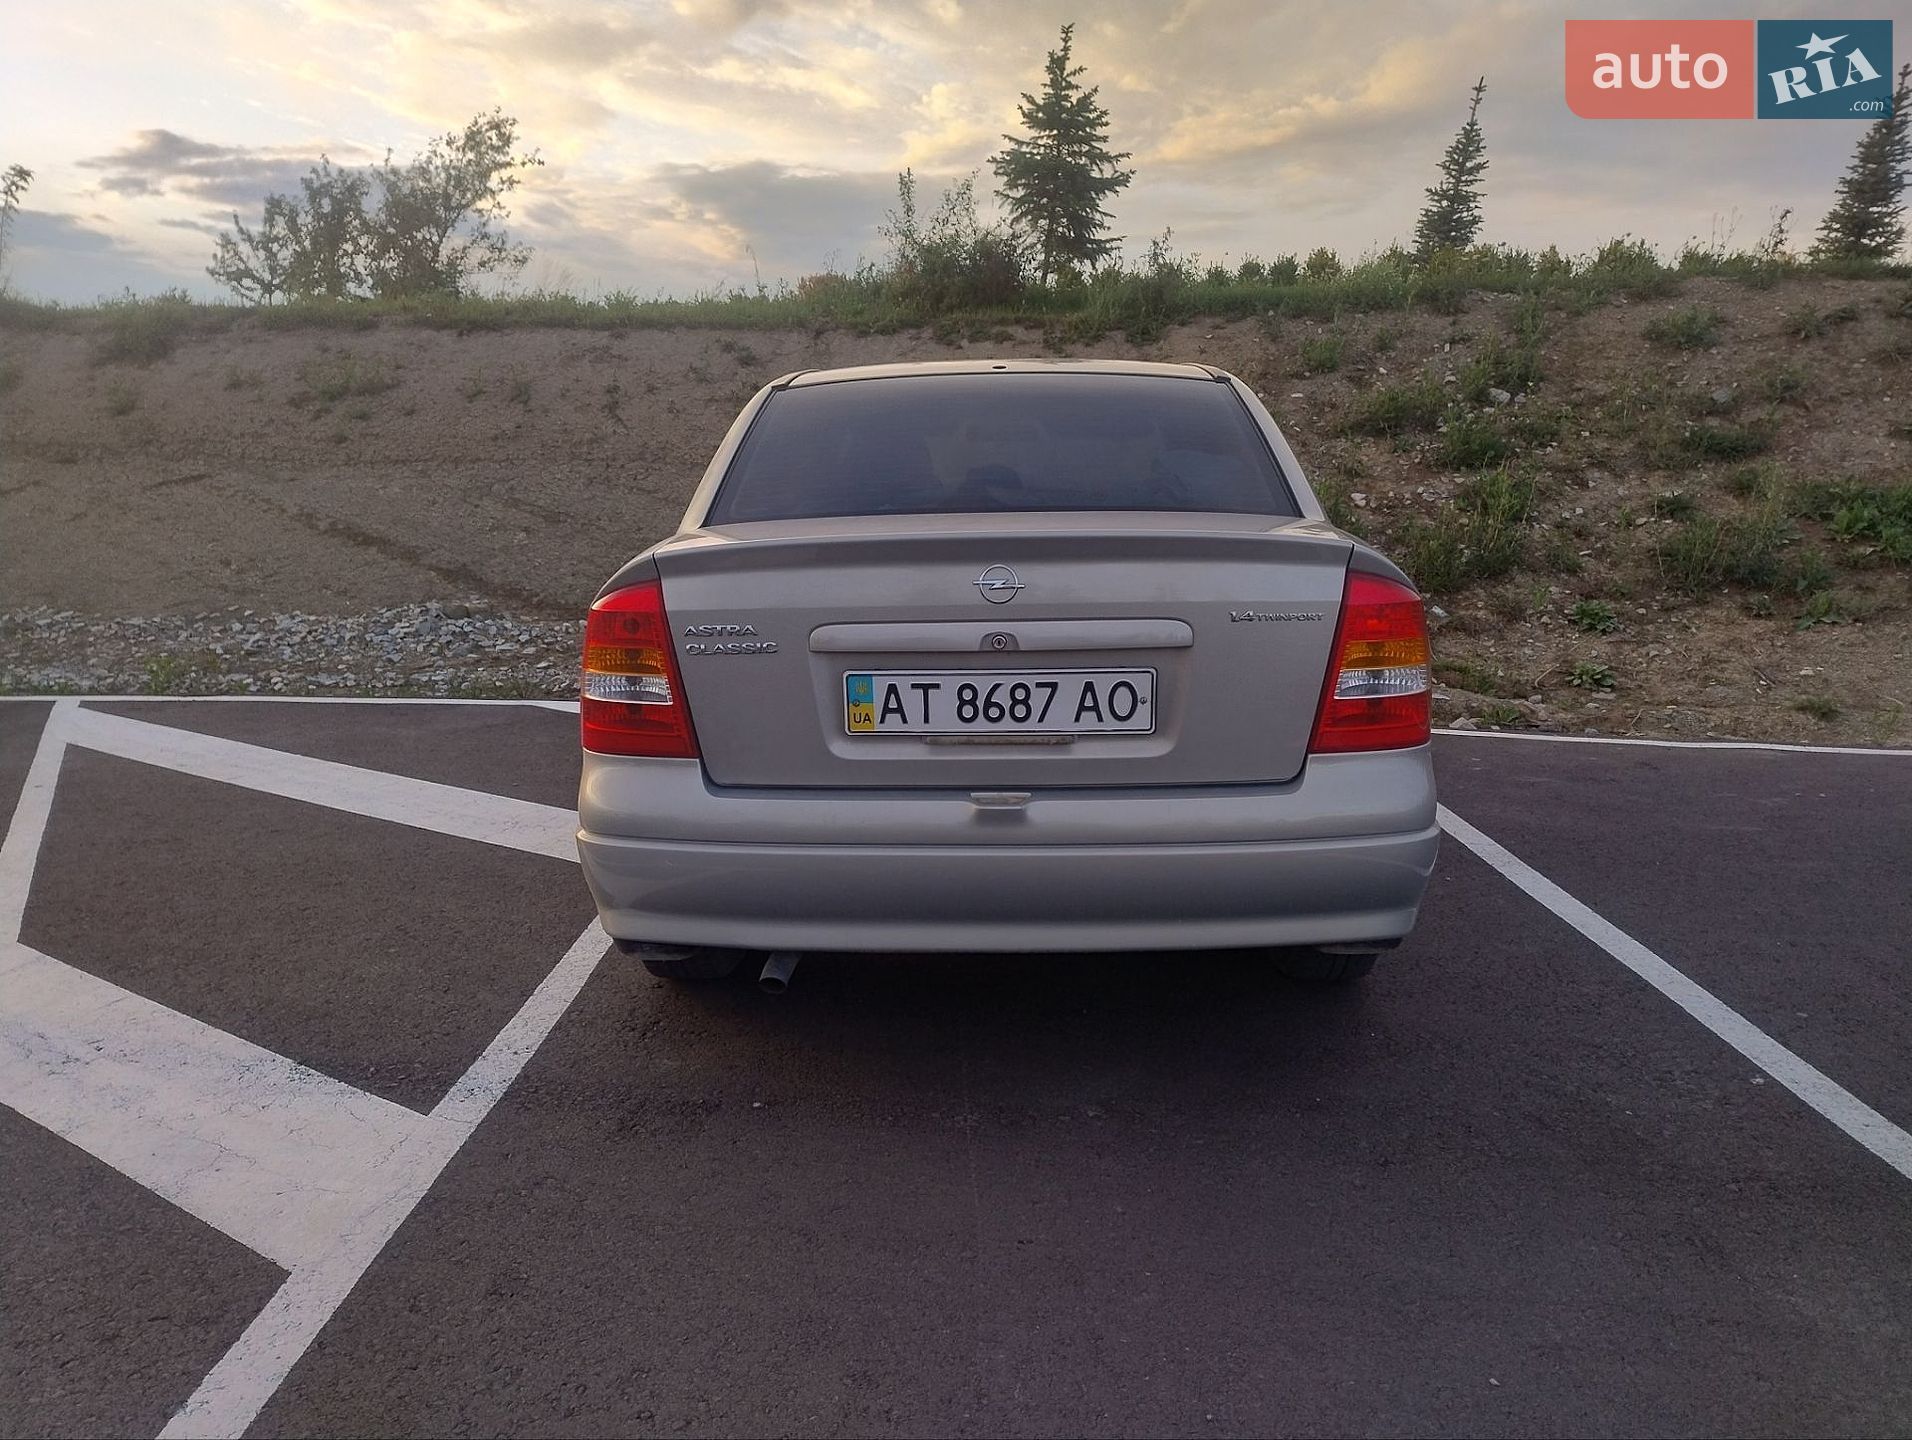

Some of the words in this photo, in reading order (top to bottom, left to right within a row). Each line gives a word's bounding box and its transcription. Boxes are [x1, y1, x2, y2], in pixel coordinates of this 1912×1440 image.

[684, 624, 758, 637] ASTRA
[685, 641, 779, 656] CLASSIC
[878, 682, 942, 725] AT
[956, 681, 1059, 724] 8687
[1073, 680, 1139, 723] AO
[852, 712, 872, 725] UA
